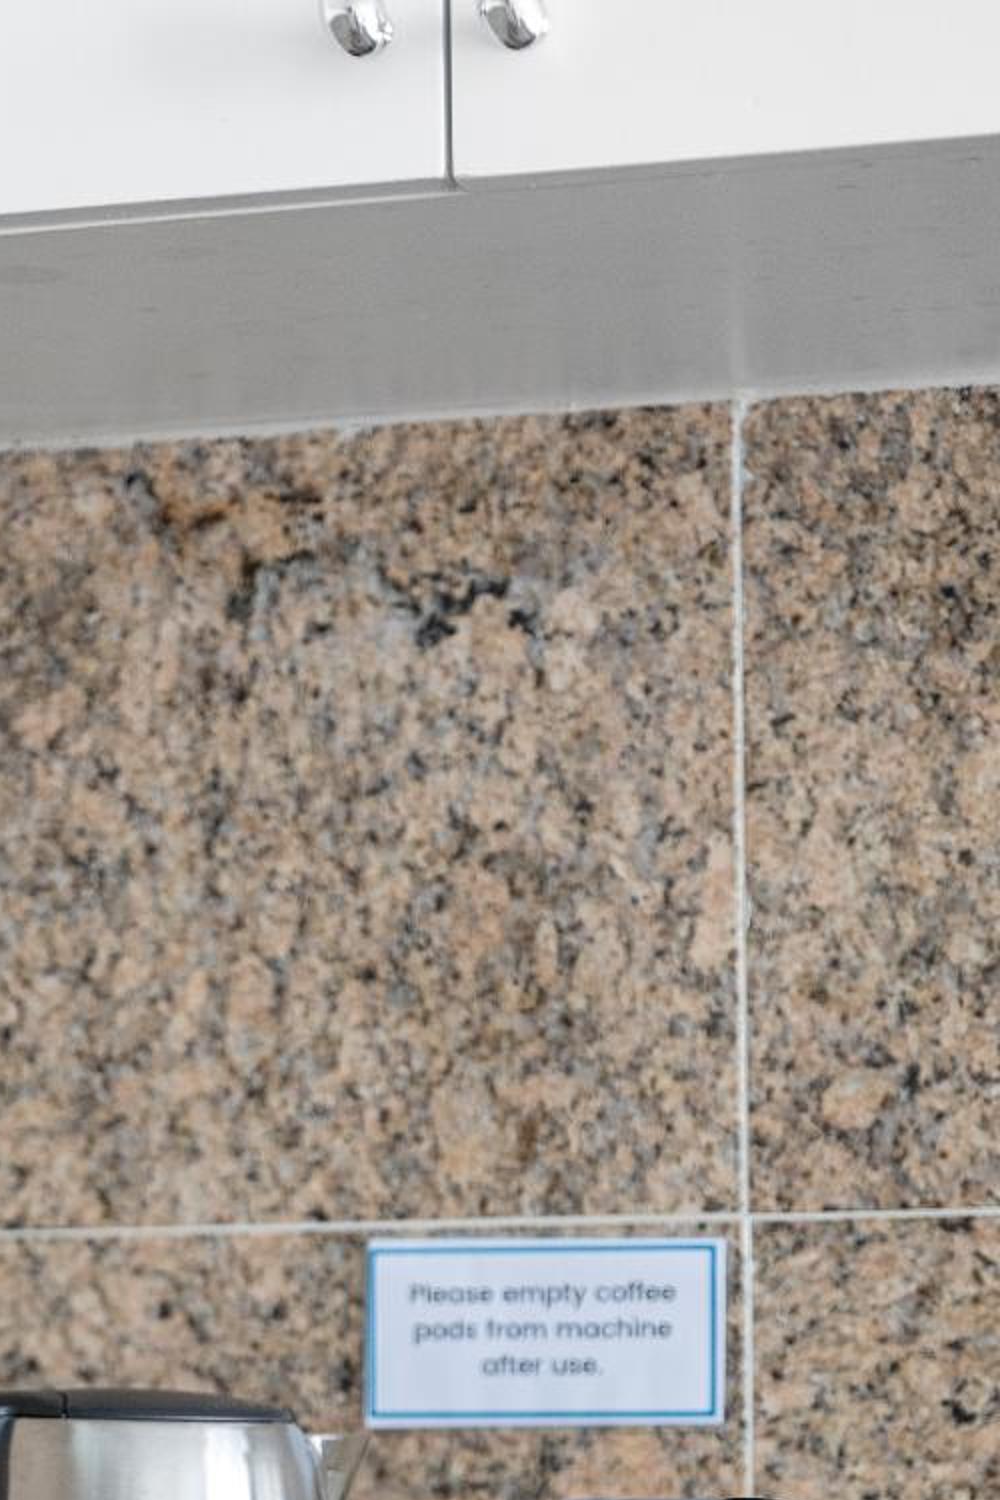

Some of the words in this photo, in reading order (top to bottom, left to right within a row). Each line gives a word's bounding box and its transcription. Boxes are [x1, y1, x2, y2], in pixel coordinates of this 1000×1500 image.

[408, 1283, 494, 1304] Please
[502, 1283, 586, 1310] empty
[596, 1281, 677, 1303] coffee
[413, 1319, 478, 1346] pods
[484, 1318, 547, 1340] from
[556, 1317, 674, 1340] machine
[481, 1355, 540, 1377] after
[551, 1357, 605, 1378] use.
